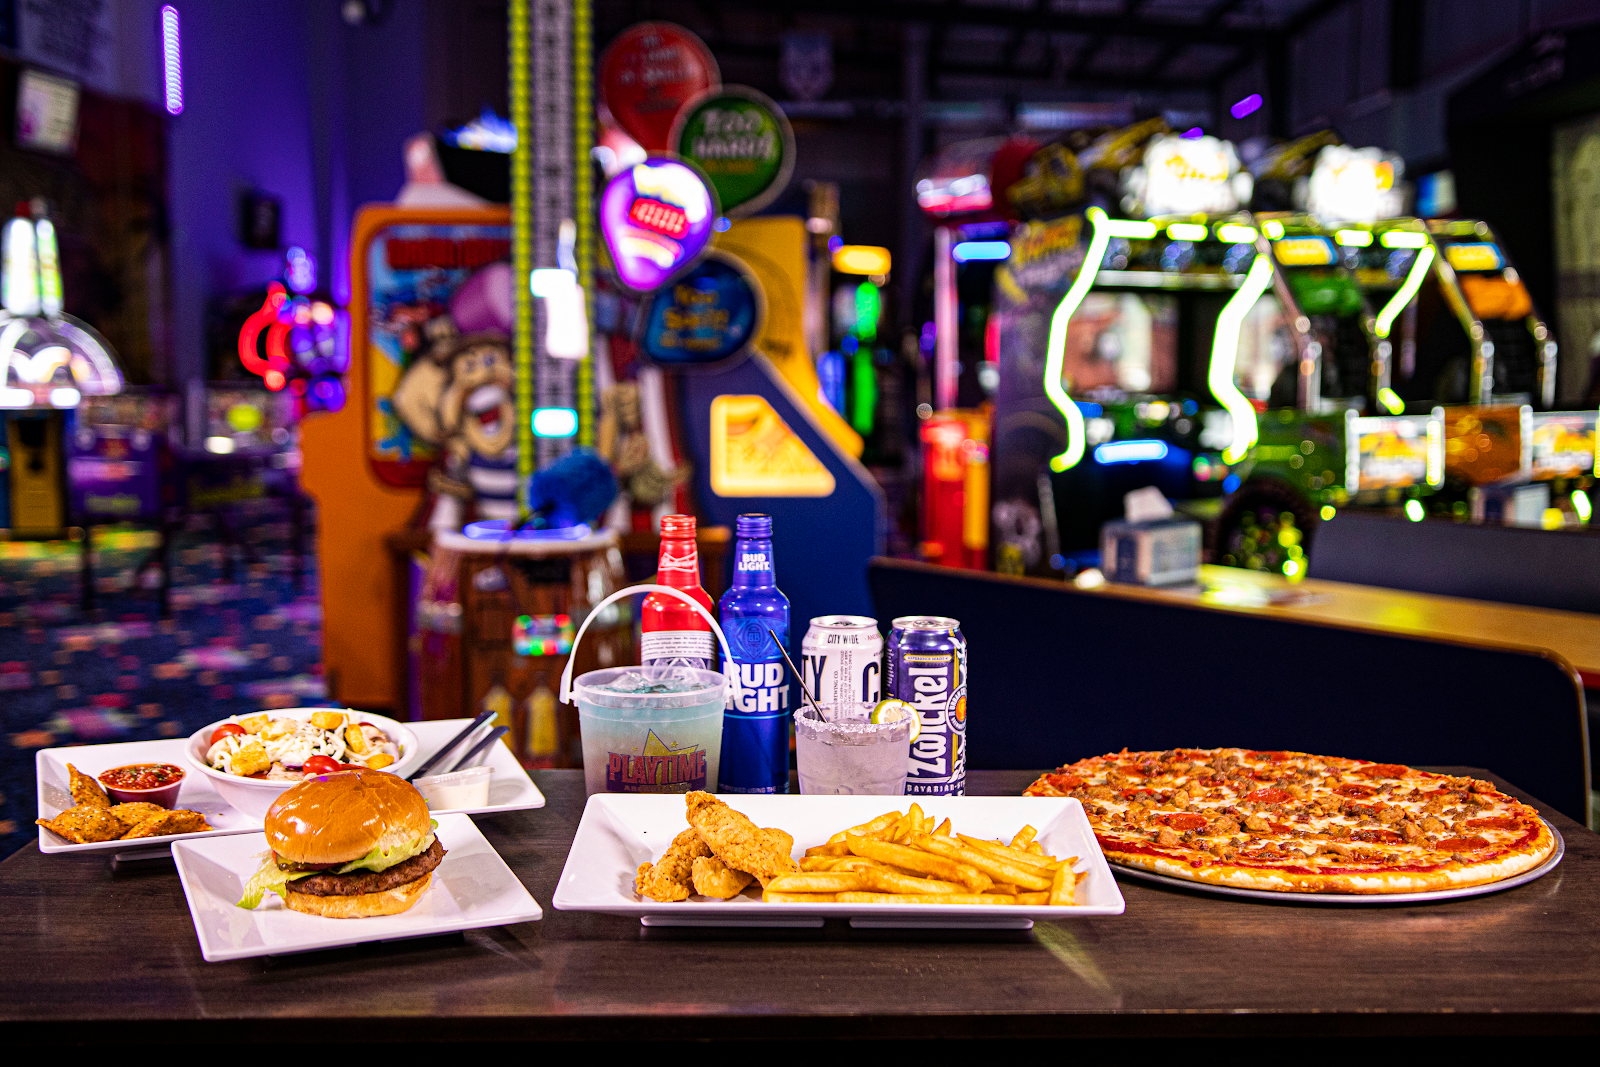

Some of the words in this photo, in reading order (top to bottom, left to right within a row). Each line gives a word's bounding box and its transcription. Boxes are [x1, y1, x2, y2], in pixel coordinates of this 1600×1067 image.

[738, 562, 770, 572] LIGHT
[742, 553, 766, 562] BUD
[827, 634, 841, 644] CITY
[843, 634, 860, 645] WIDE
[723, 661, 784, 688] BUD
[725, 684, 790, 713] IGHT
[608, 749, 706, 785] PLAYTIME
